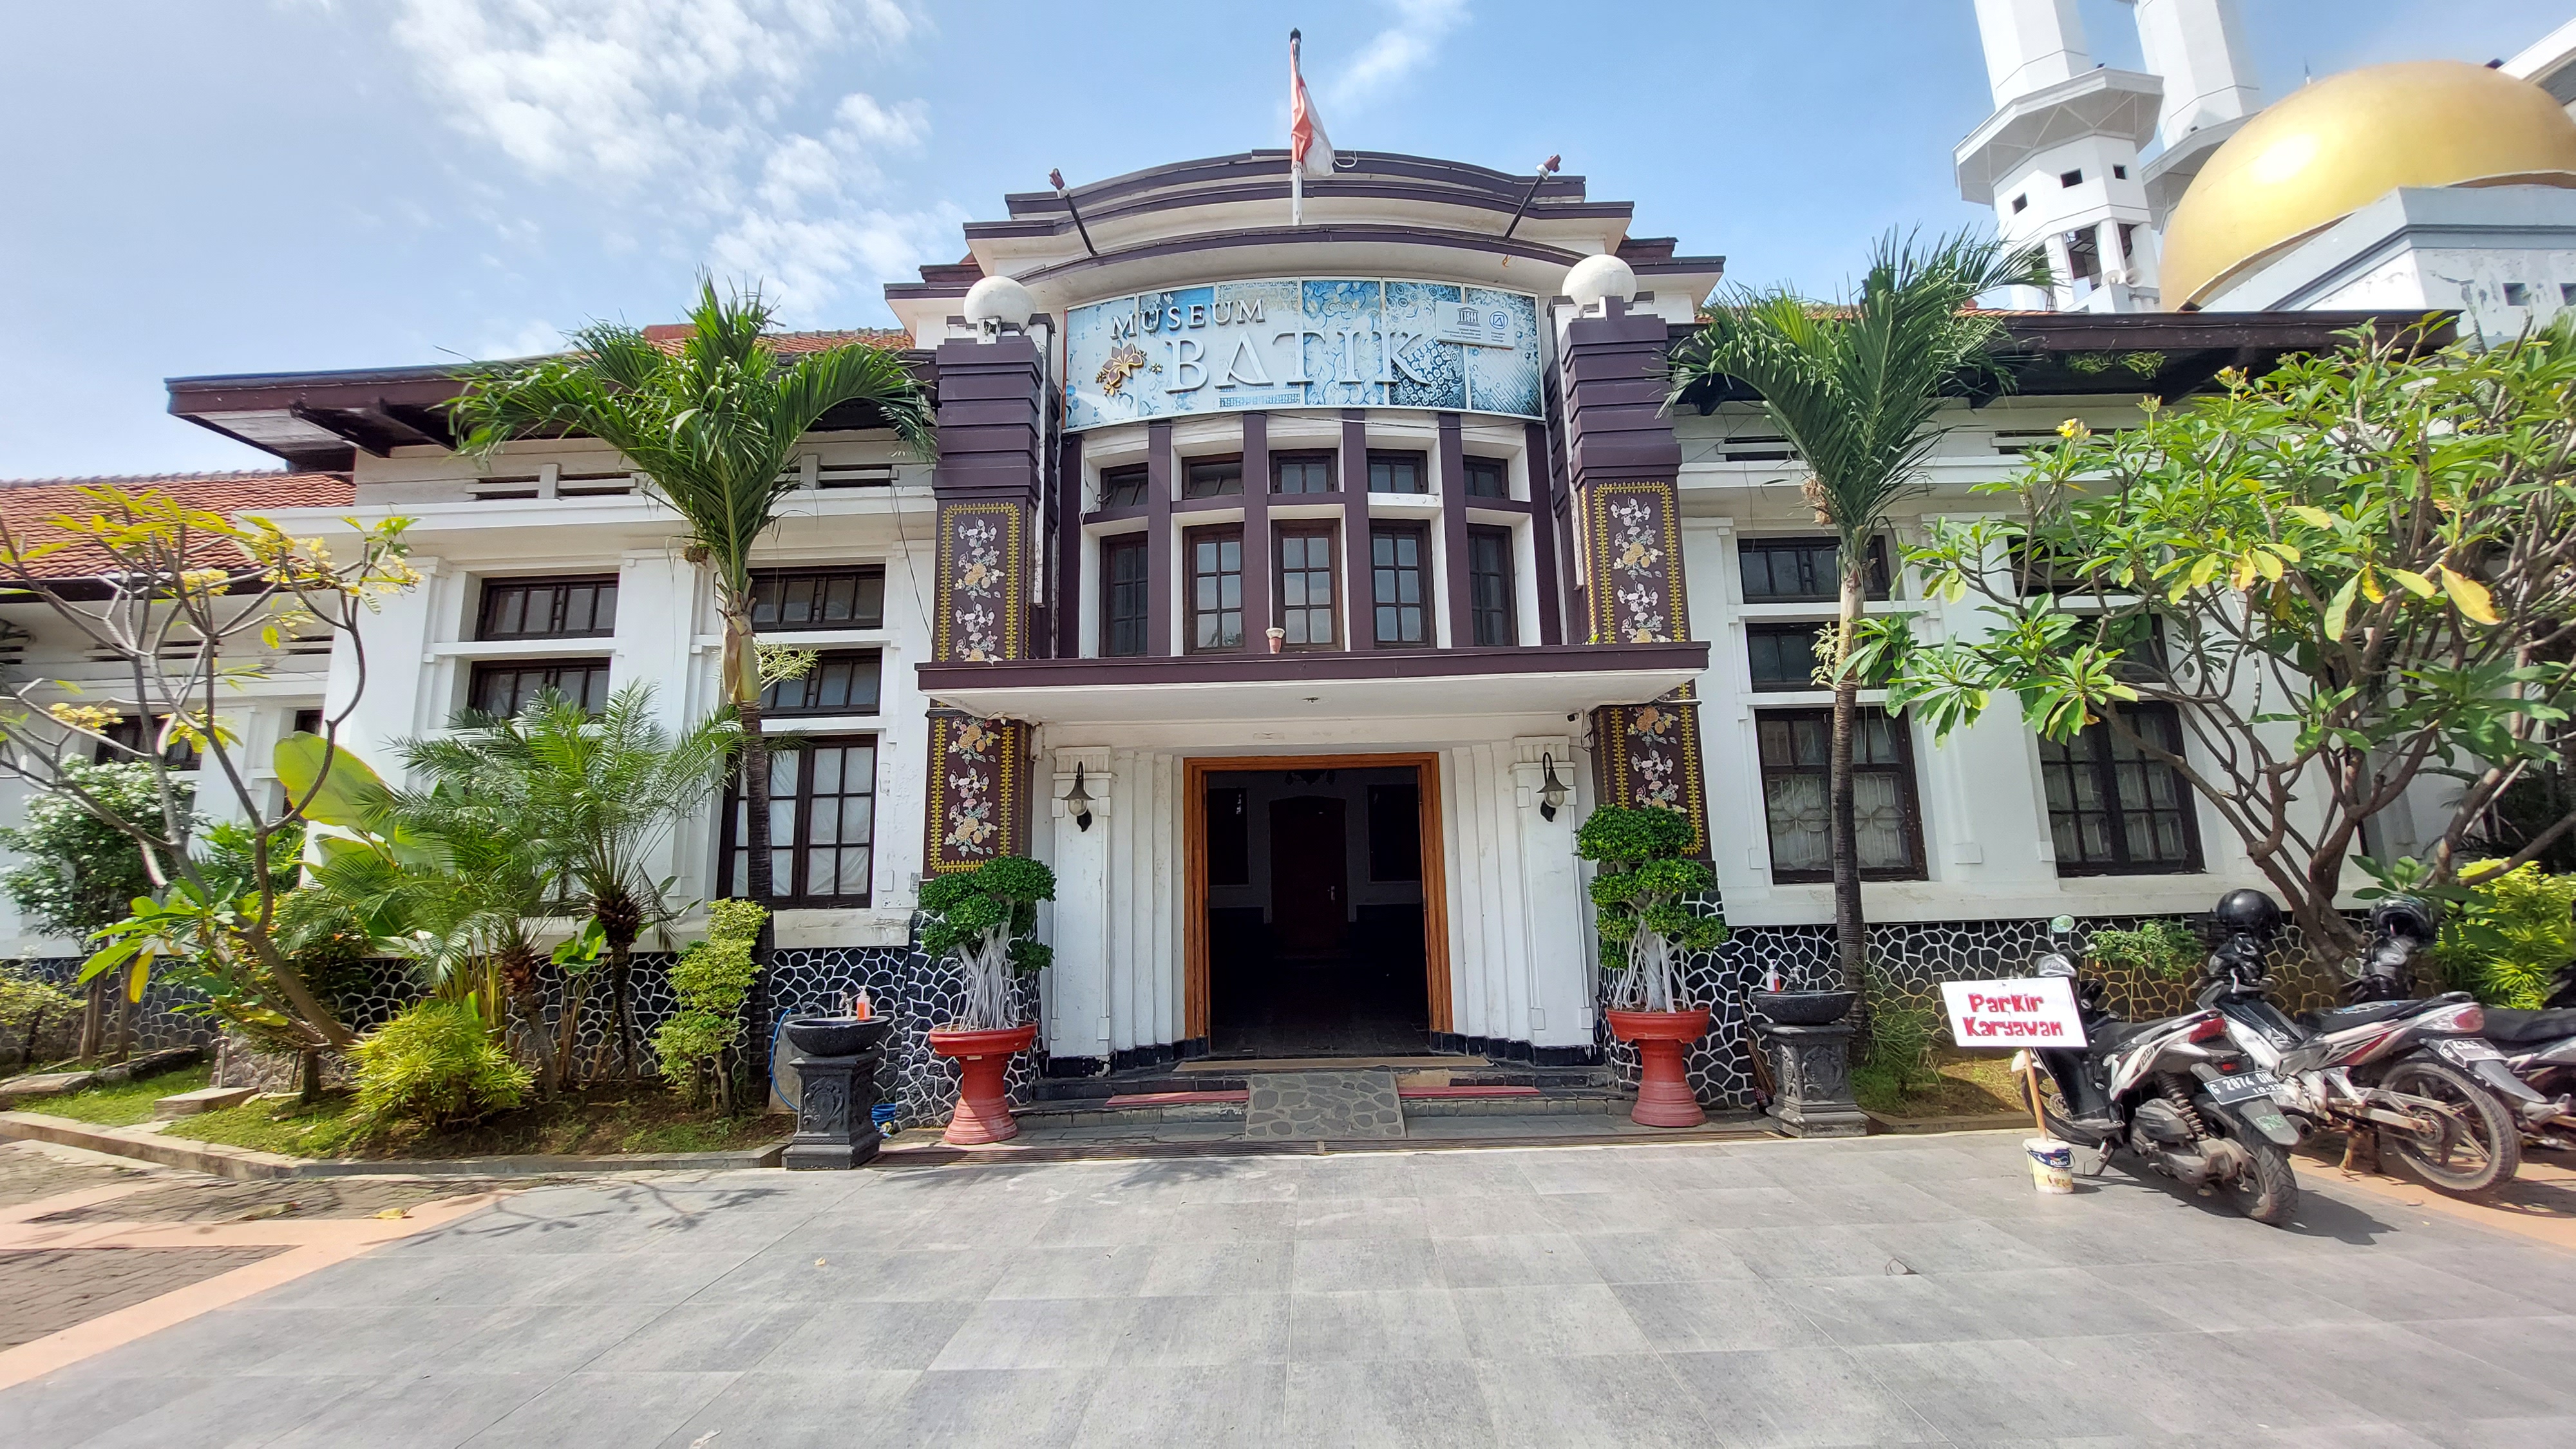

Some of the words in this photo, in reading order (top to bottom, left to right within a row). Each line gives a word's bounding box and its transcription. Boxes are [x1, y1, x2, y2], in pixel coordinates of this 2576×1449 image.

[1110, 298, 1266, 340] MUSEUM
[1164, 330, 1432, 393] BATIK
[1962, 1016, 2063, 1036] Karyawan
[2209, 1083, 2221, 1095] G
[2222, 1075, 2255, 1091] 2874
